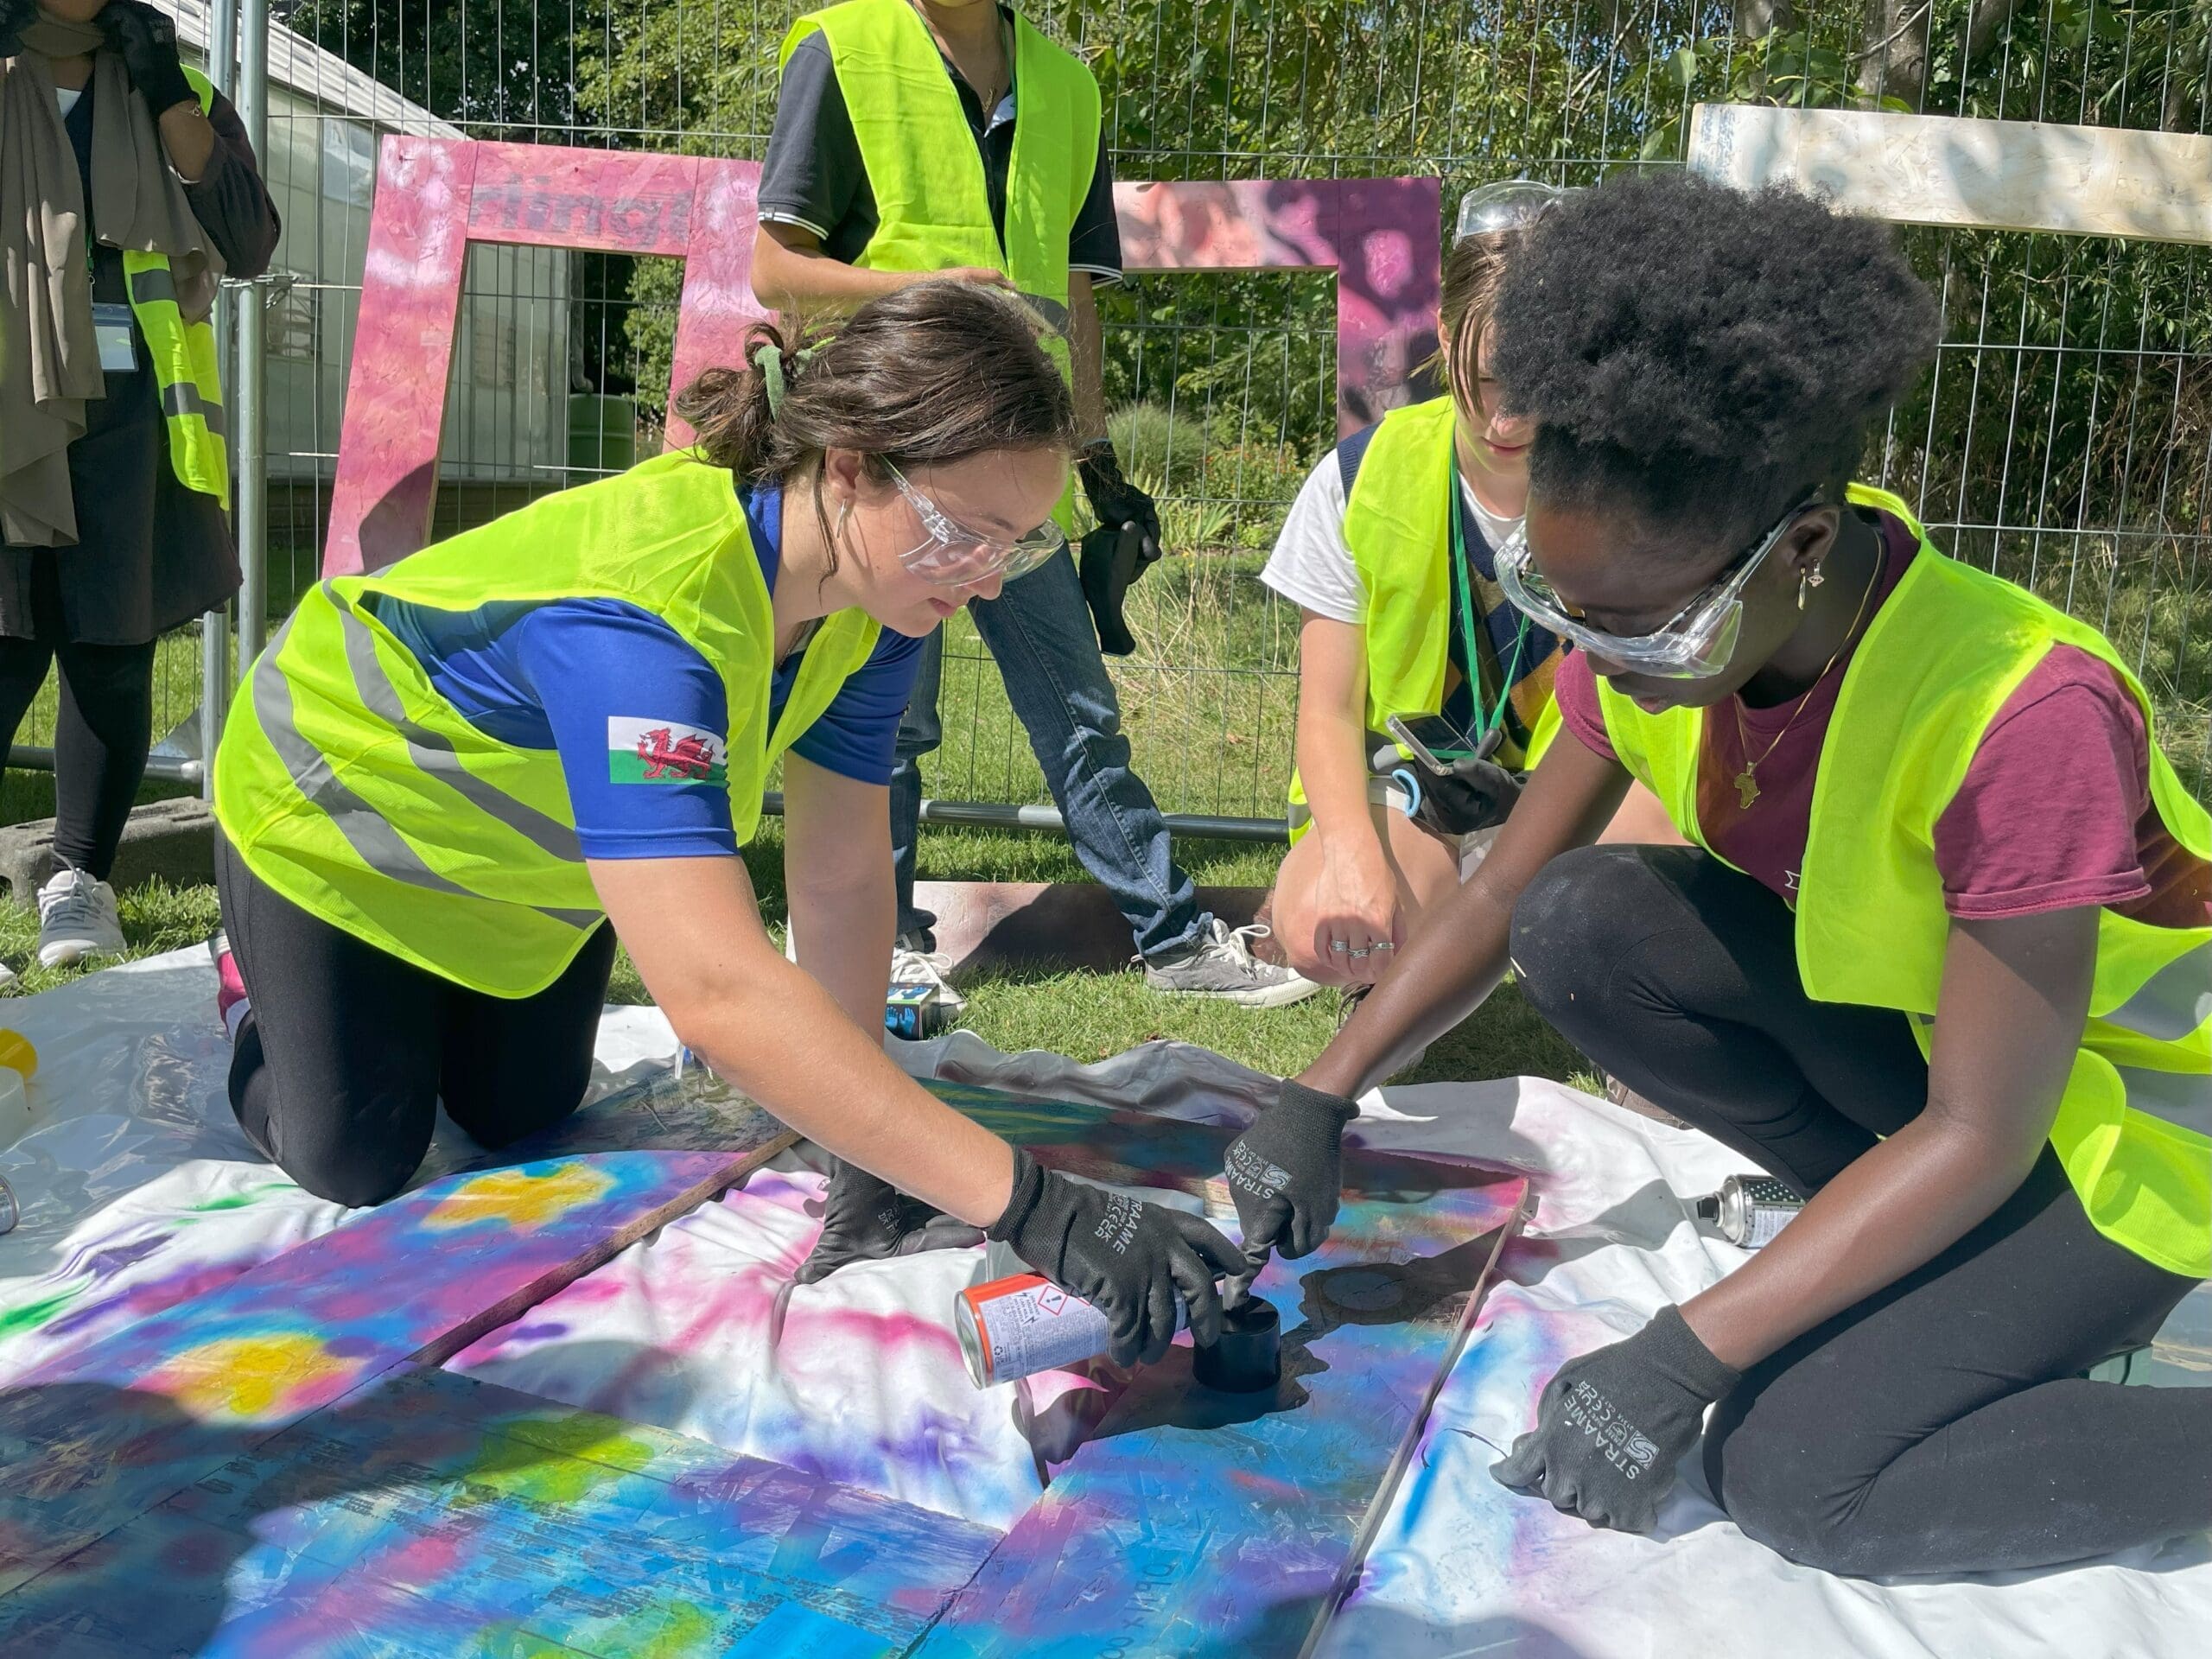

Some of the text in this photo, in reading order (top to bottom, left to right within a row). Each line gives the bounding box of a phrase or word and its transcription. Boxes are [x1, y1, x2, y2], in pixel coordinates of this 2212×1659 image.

[1101, 1224, 1118, 1243] UK
[1113, 1200, 1143, 1255] RAAME
[1574, 1383, 1592, 1407] UK
[1580, 1380, 1599, 1400] CA
[1564, 1395, 1641, 1479] STRAAME
